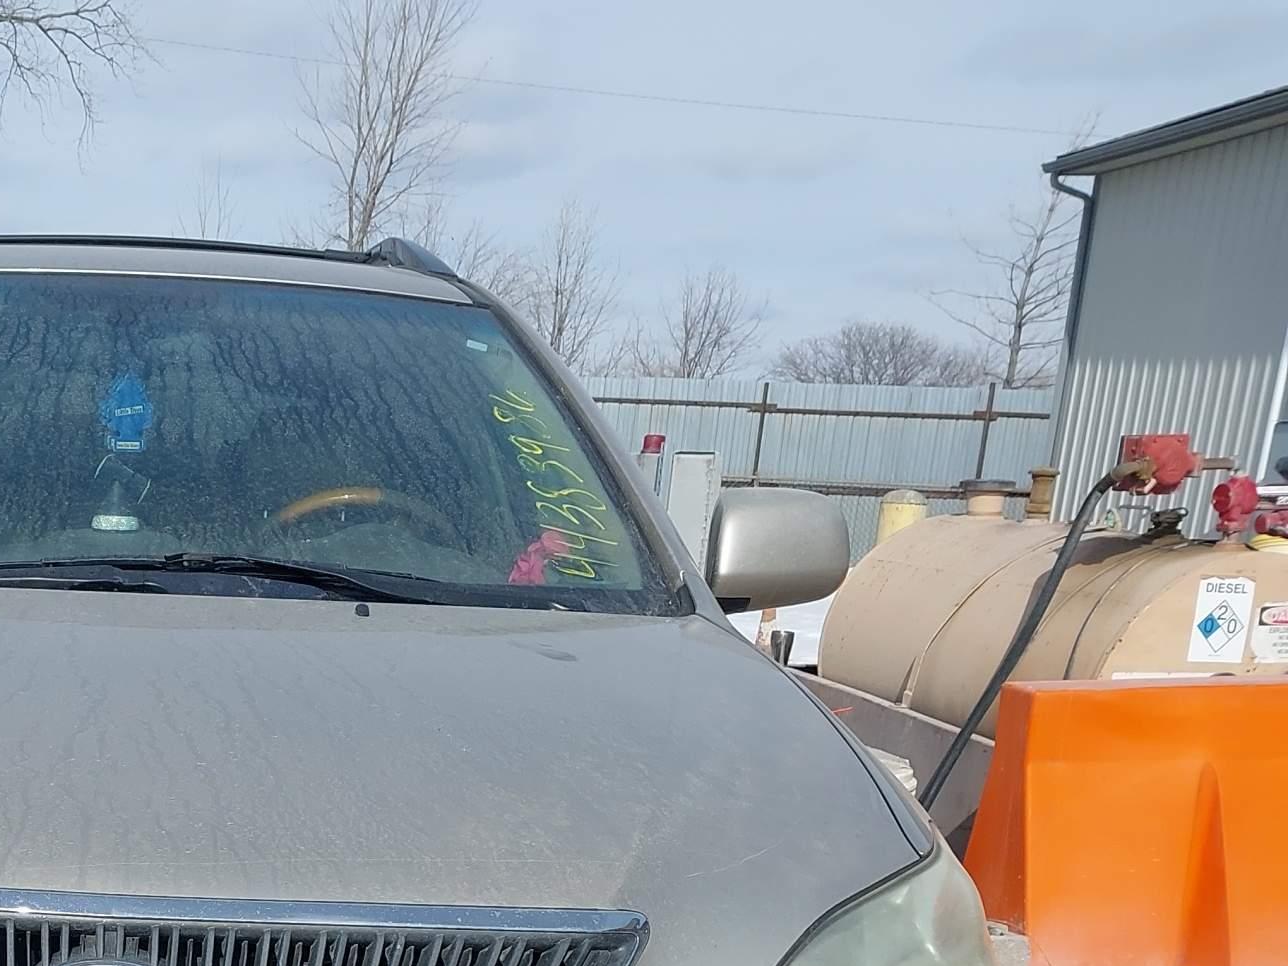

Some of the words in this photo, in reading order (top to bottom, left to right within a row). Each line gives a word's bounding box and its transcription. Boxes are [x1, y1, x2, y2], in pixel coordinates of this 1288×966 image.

[1206, 582, 1248, 594] DIESEL
[1217, 604, 1228, 621] 2
[1204, 617, 1215, 634] 0
[1226, 618, 1238, 634] 0
